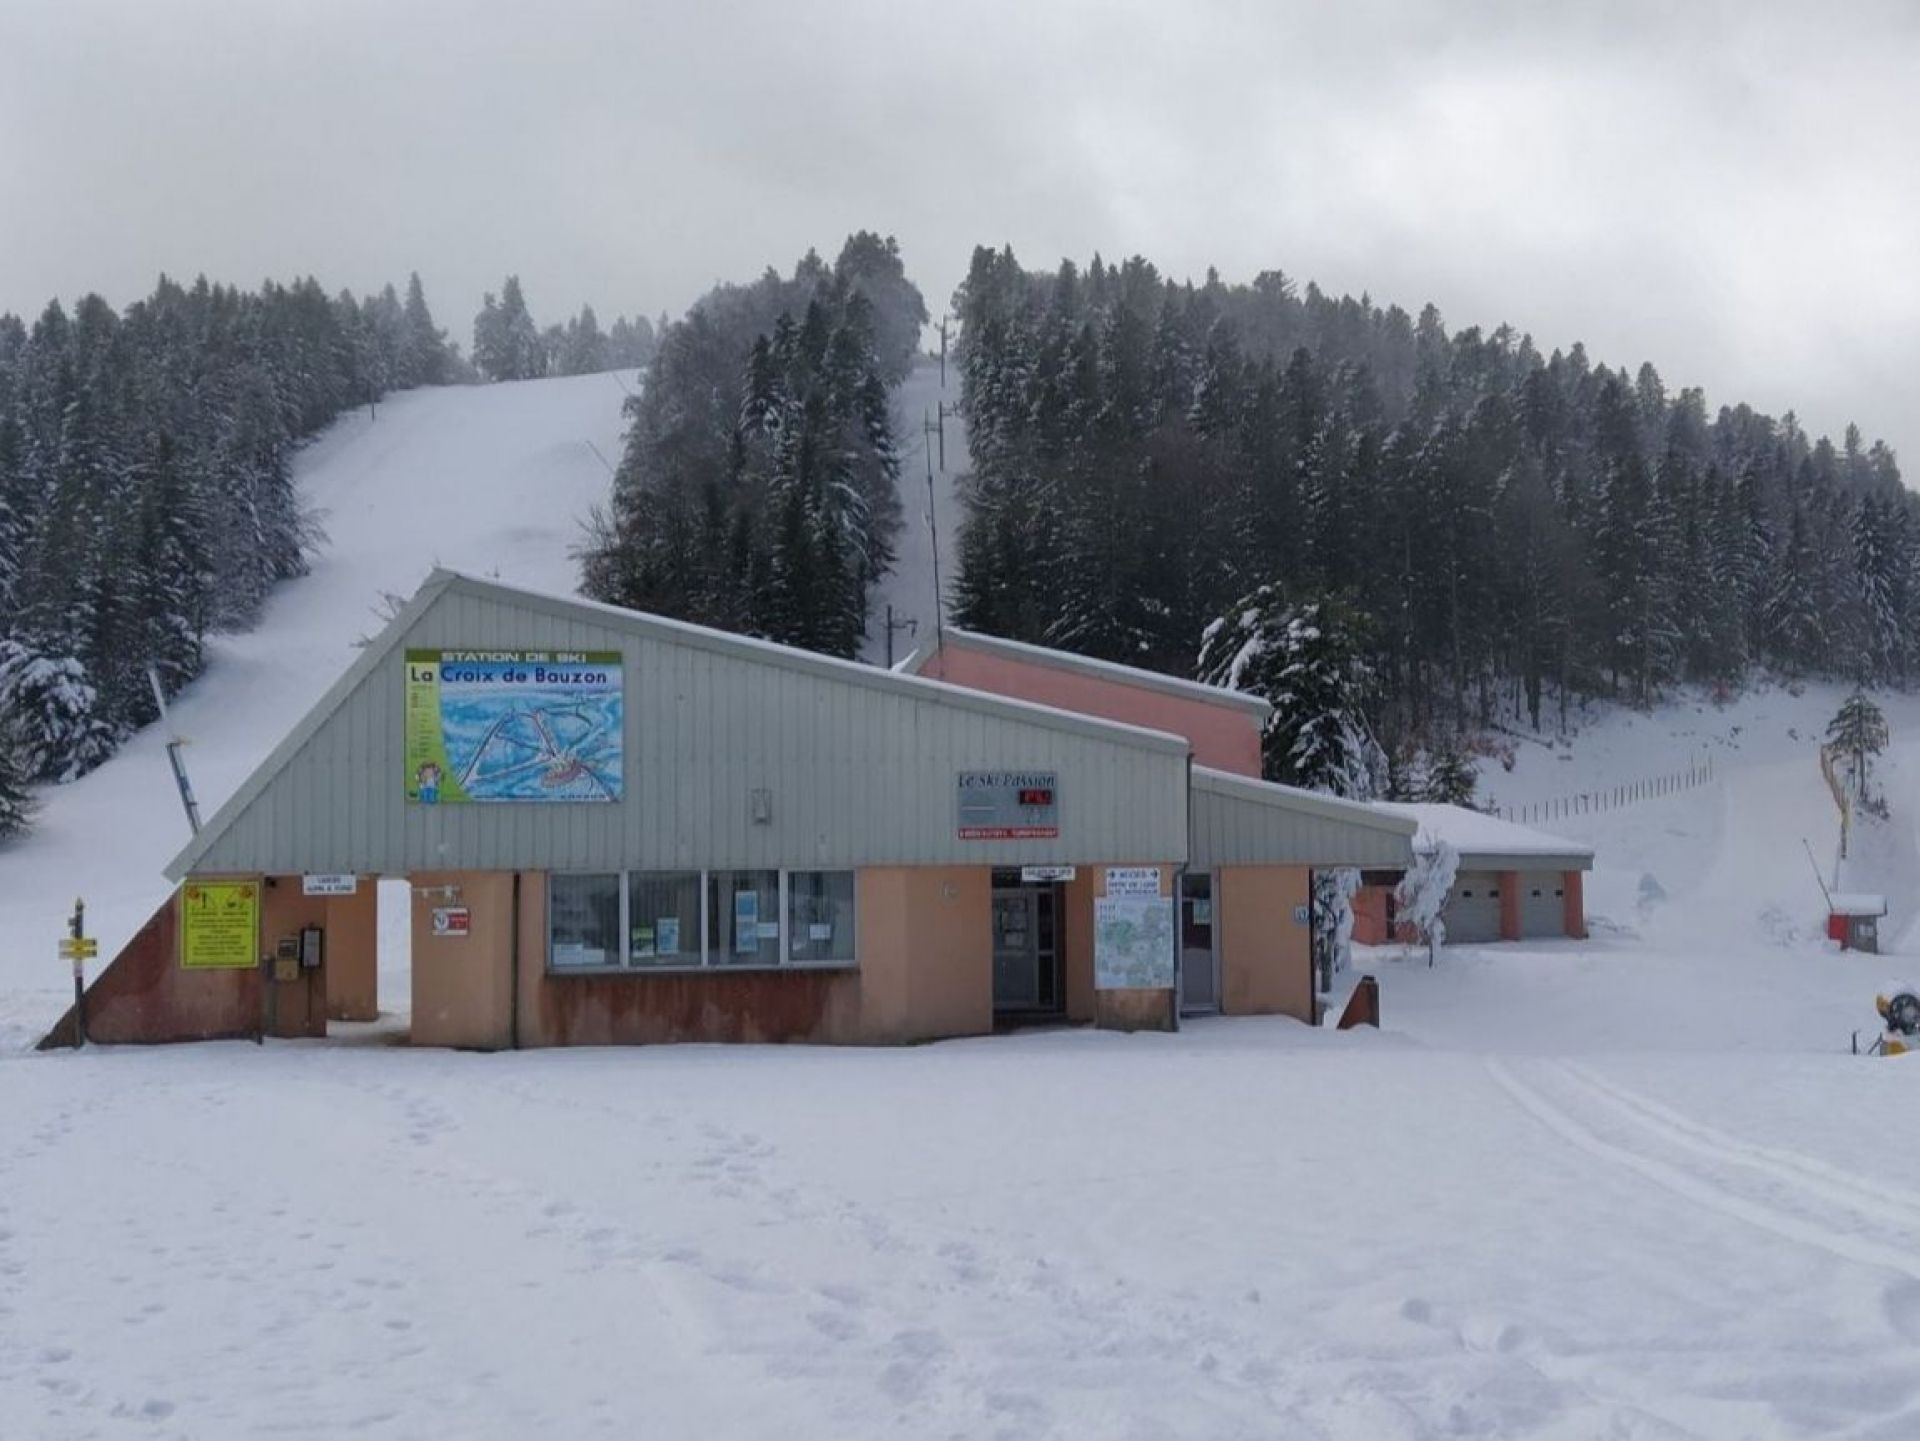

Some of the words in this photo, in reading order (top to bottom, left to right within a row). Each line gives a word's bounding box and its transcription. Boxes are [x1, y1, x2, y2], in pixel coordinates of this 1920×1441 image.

[441, 652, 519, 662] STATION
[525, 653, 549, 662] DE
[557, 653, 586, 663] SKI
[411, 665, 433, 682] La
[441, 666, 494, 682] Croix
[502, 667, 527, 682] de
